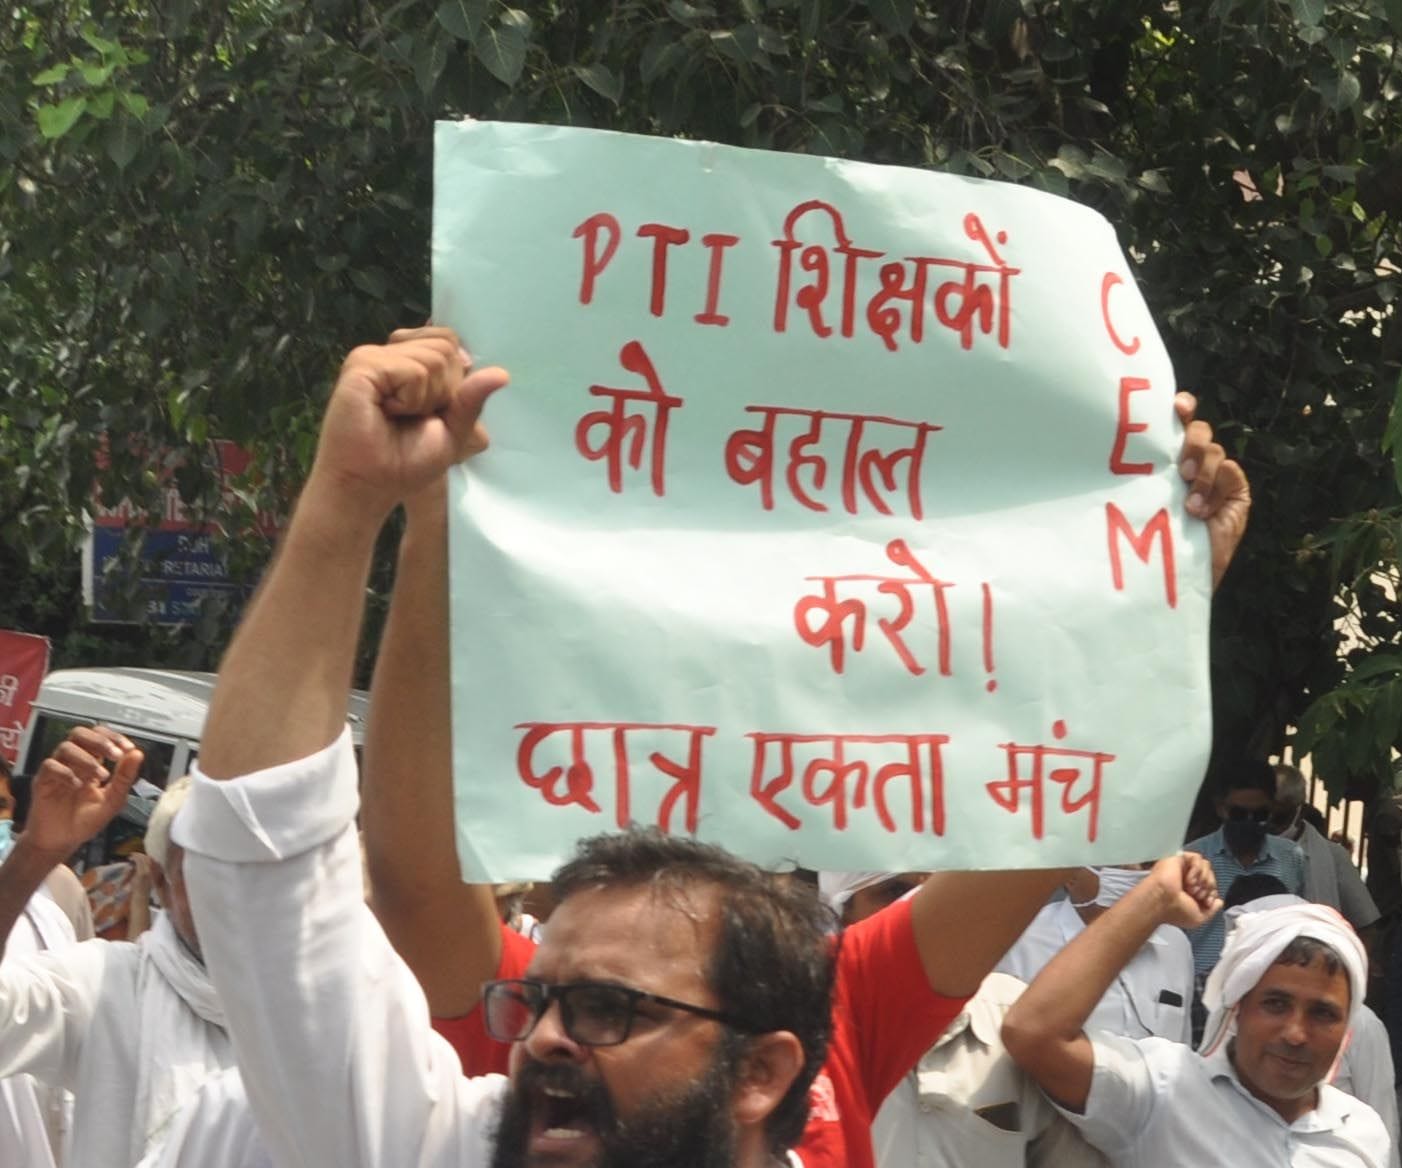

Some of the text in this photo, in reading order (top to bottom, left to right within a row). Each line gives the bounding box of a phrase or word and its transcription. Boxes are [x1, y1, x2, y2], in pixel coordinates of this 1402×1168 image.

[573, 201, 1020, 350] PTI शिक्षकों
[576, 342, 941, 521] को बहाल
[515, 721, 1114, 840] छात्र एकता मंच
